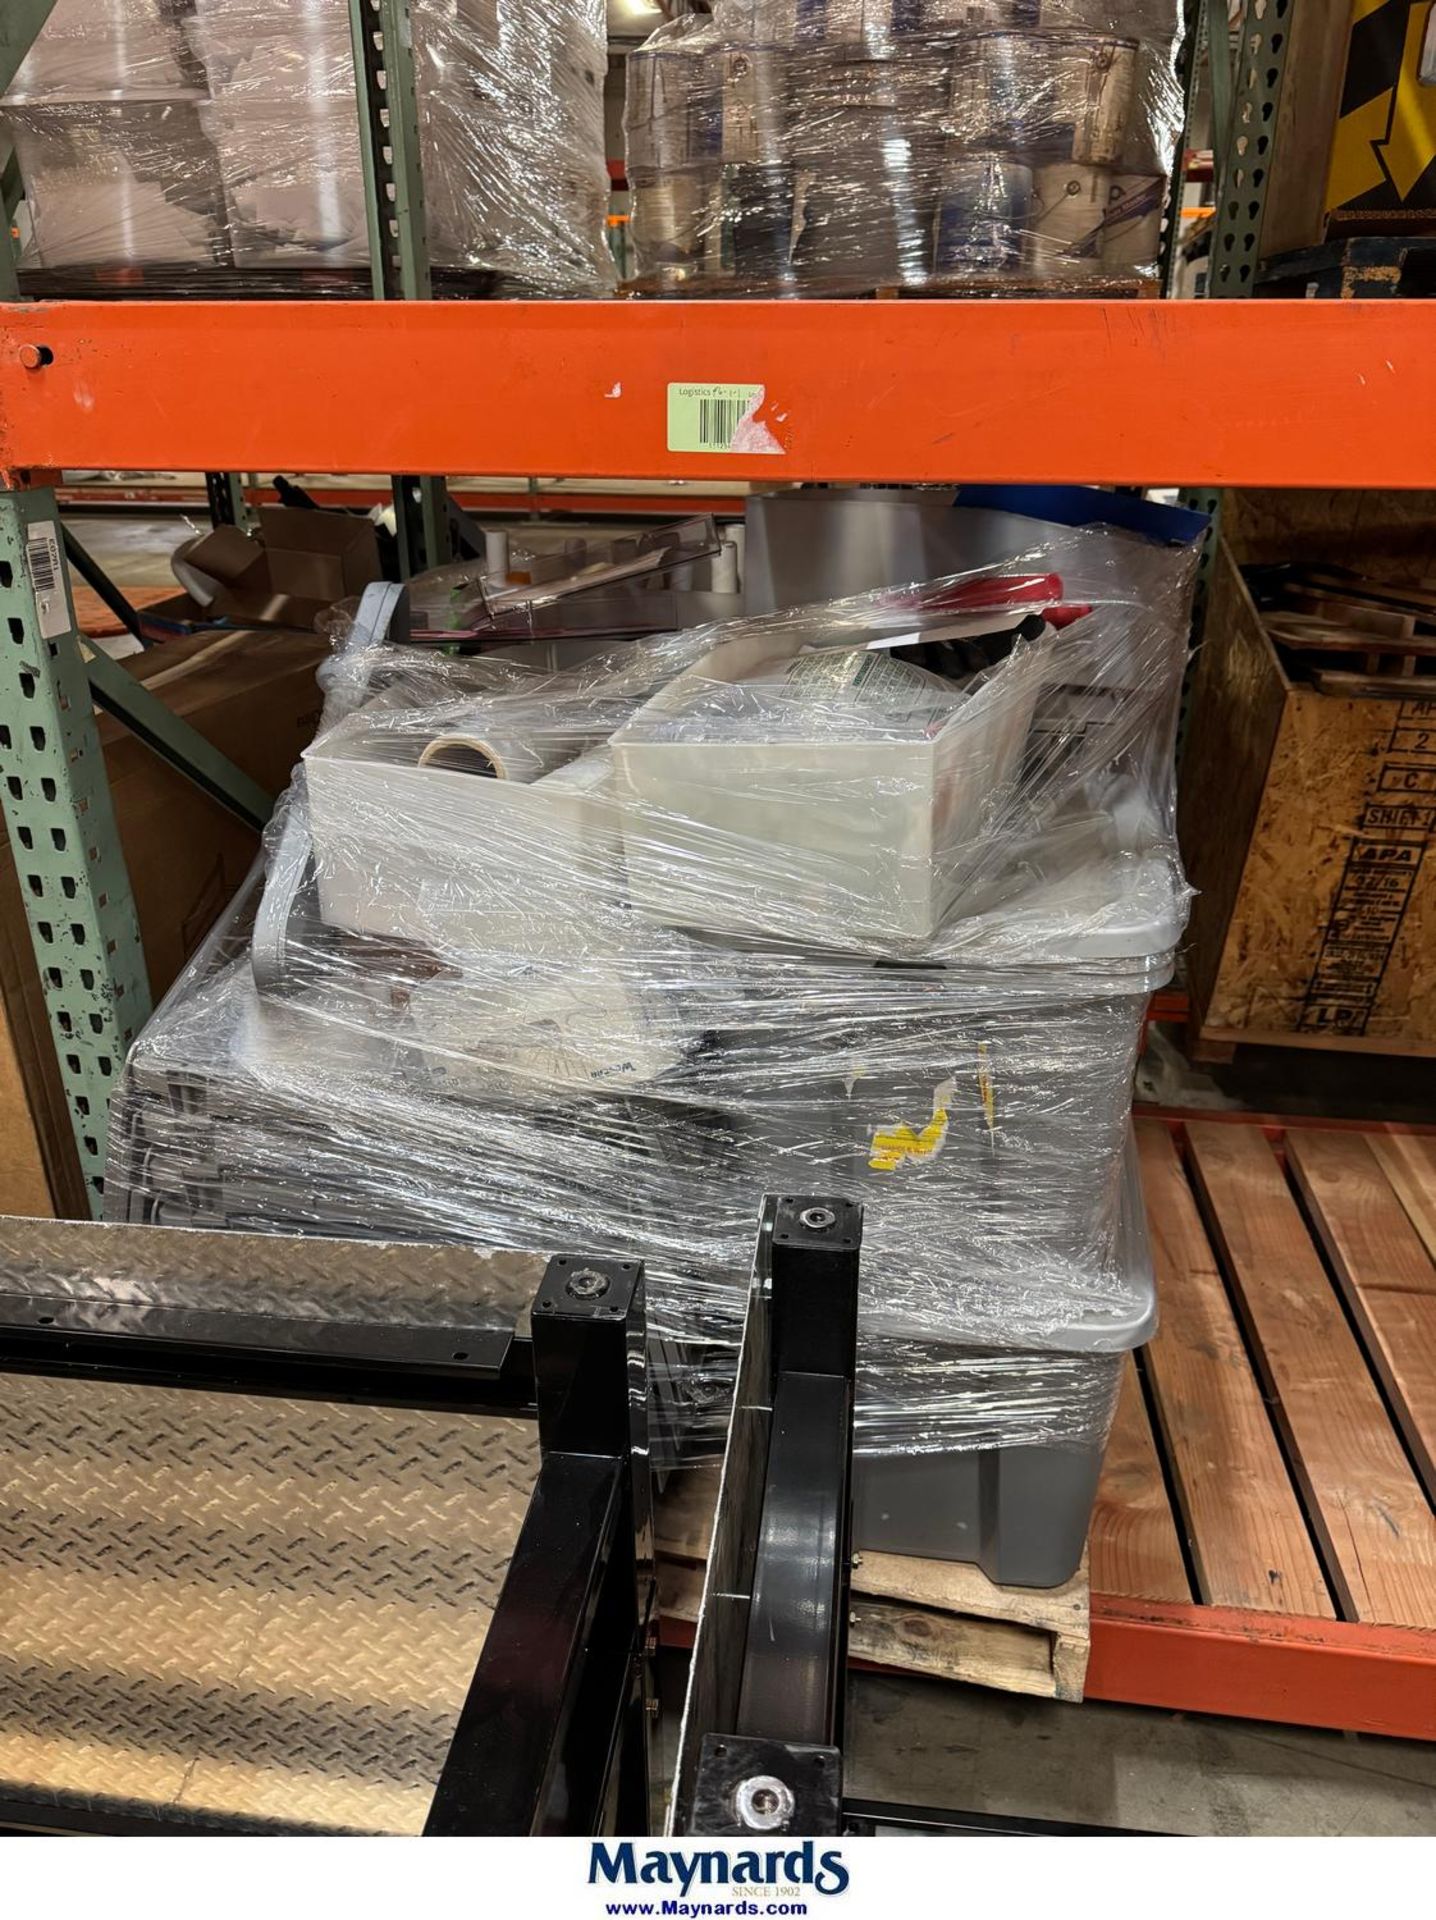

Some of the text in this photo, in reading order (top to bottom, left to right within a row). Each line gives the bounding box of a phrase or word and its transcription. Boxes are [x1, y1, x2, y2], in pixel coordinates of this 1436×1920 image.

[679, 387, 711, 398] Logistics
[1413, 731, 1430, 750] 2
[1403, 771, 1419, 789] C
[1360, 847, 1412, 863] APA
